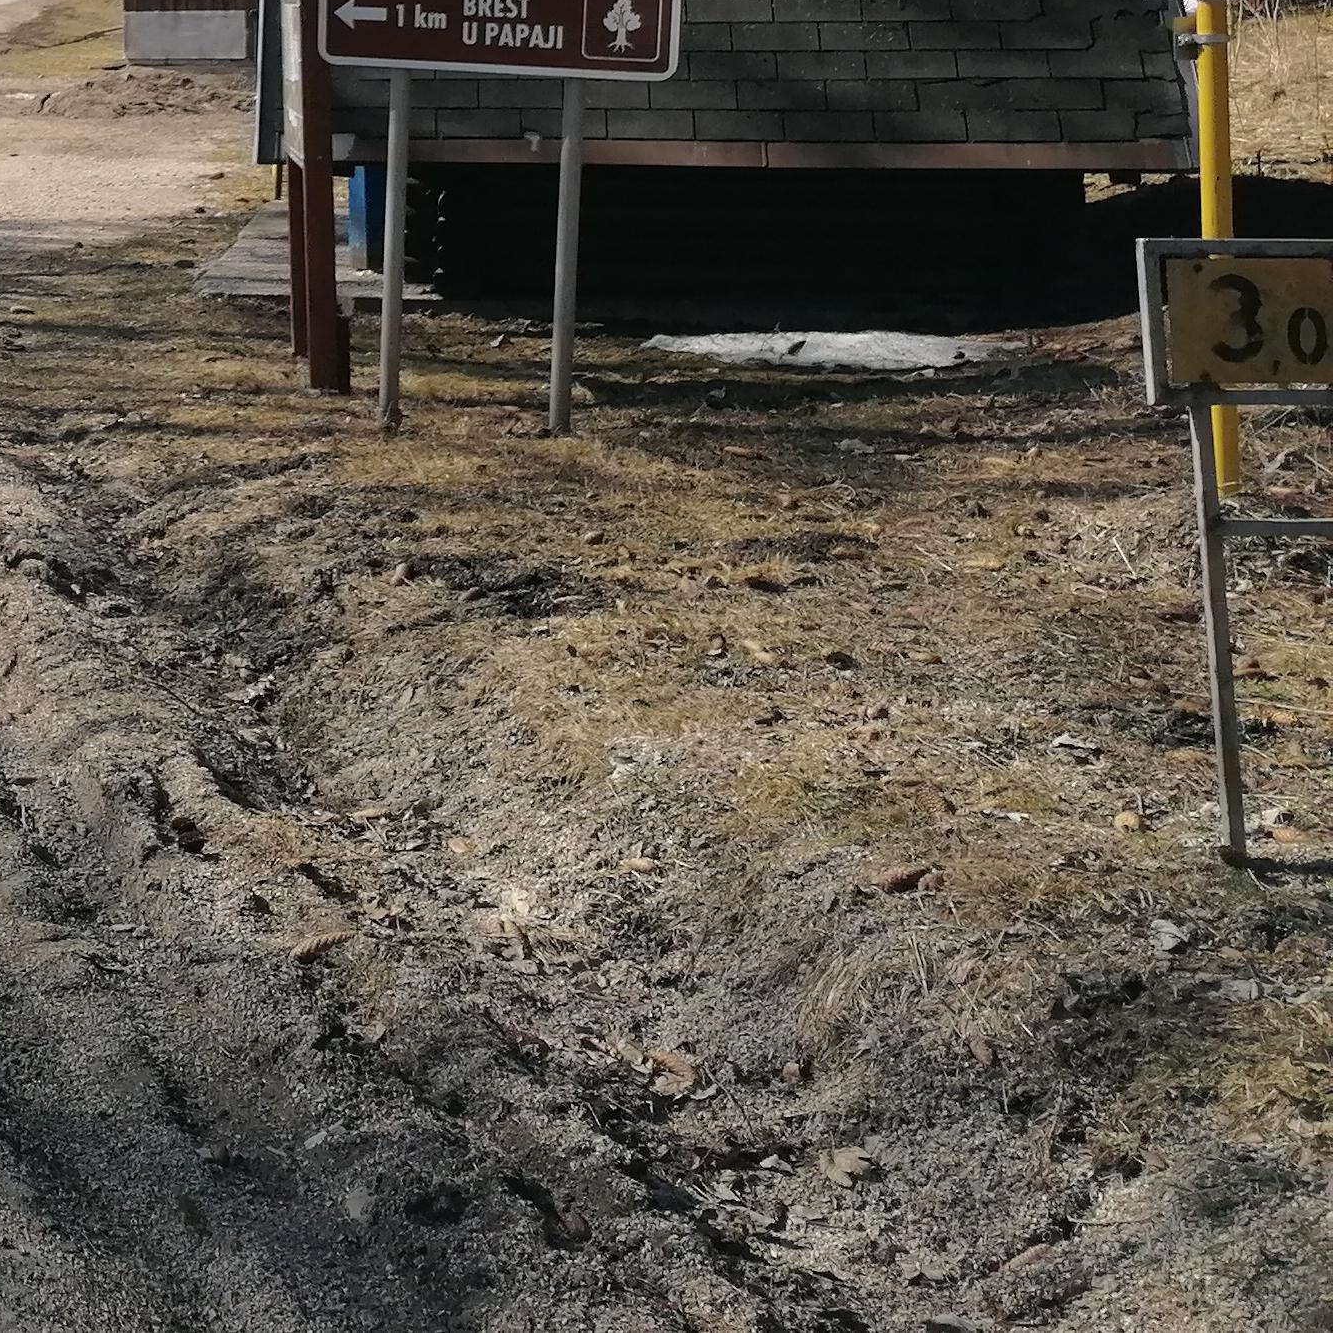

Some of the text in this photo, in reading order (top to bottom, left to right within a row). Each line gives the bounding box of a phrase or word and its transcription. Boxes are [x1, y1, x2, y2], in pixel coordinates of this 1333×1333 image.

[395, 3, 448, 30] 1 km
[462, 21, 565, 50] U PAPAJI
